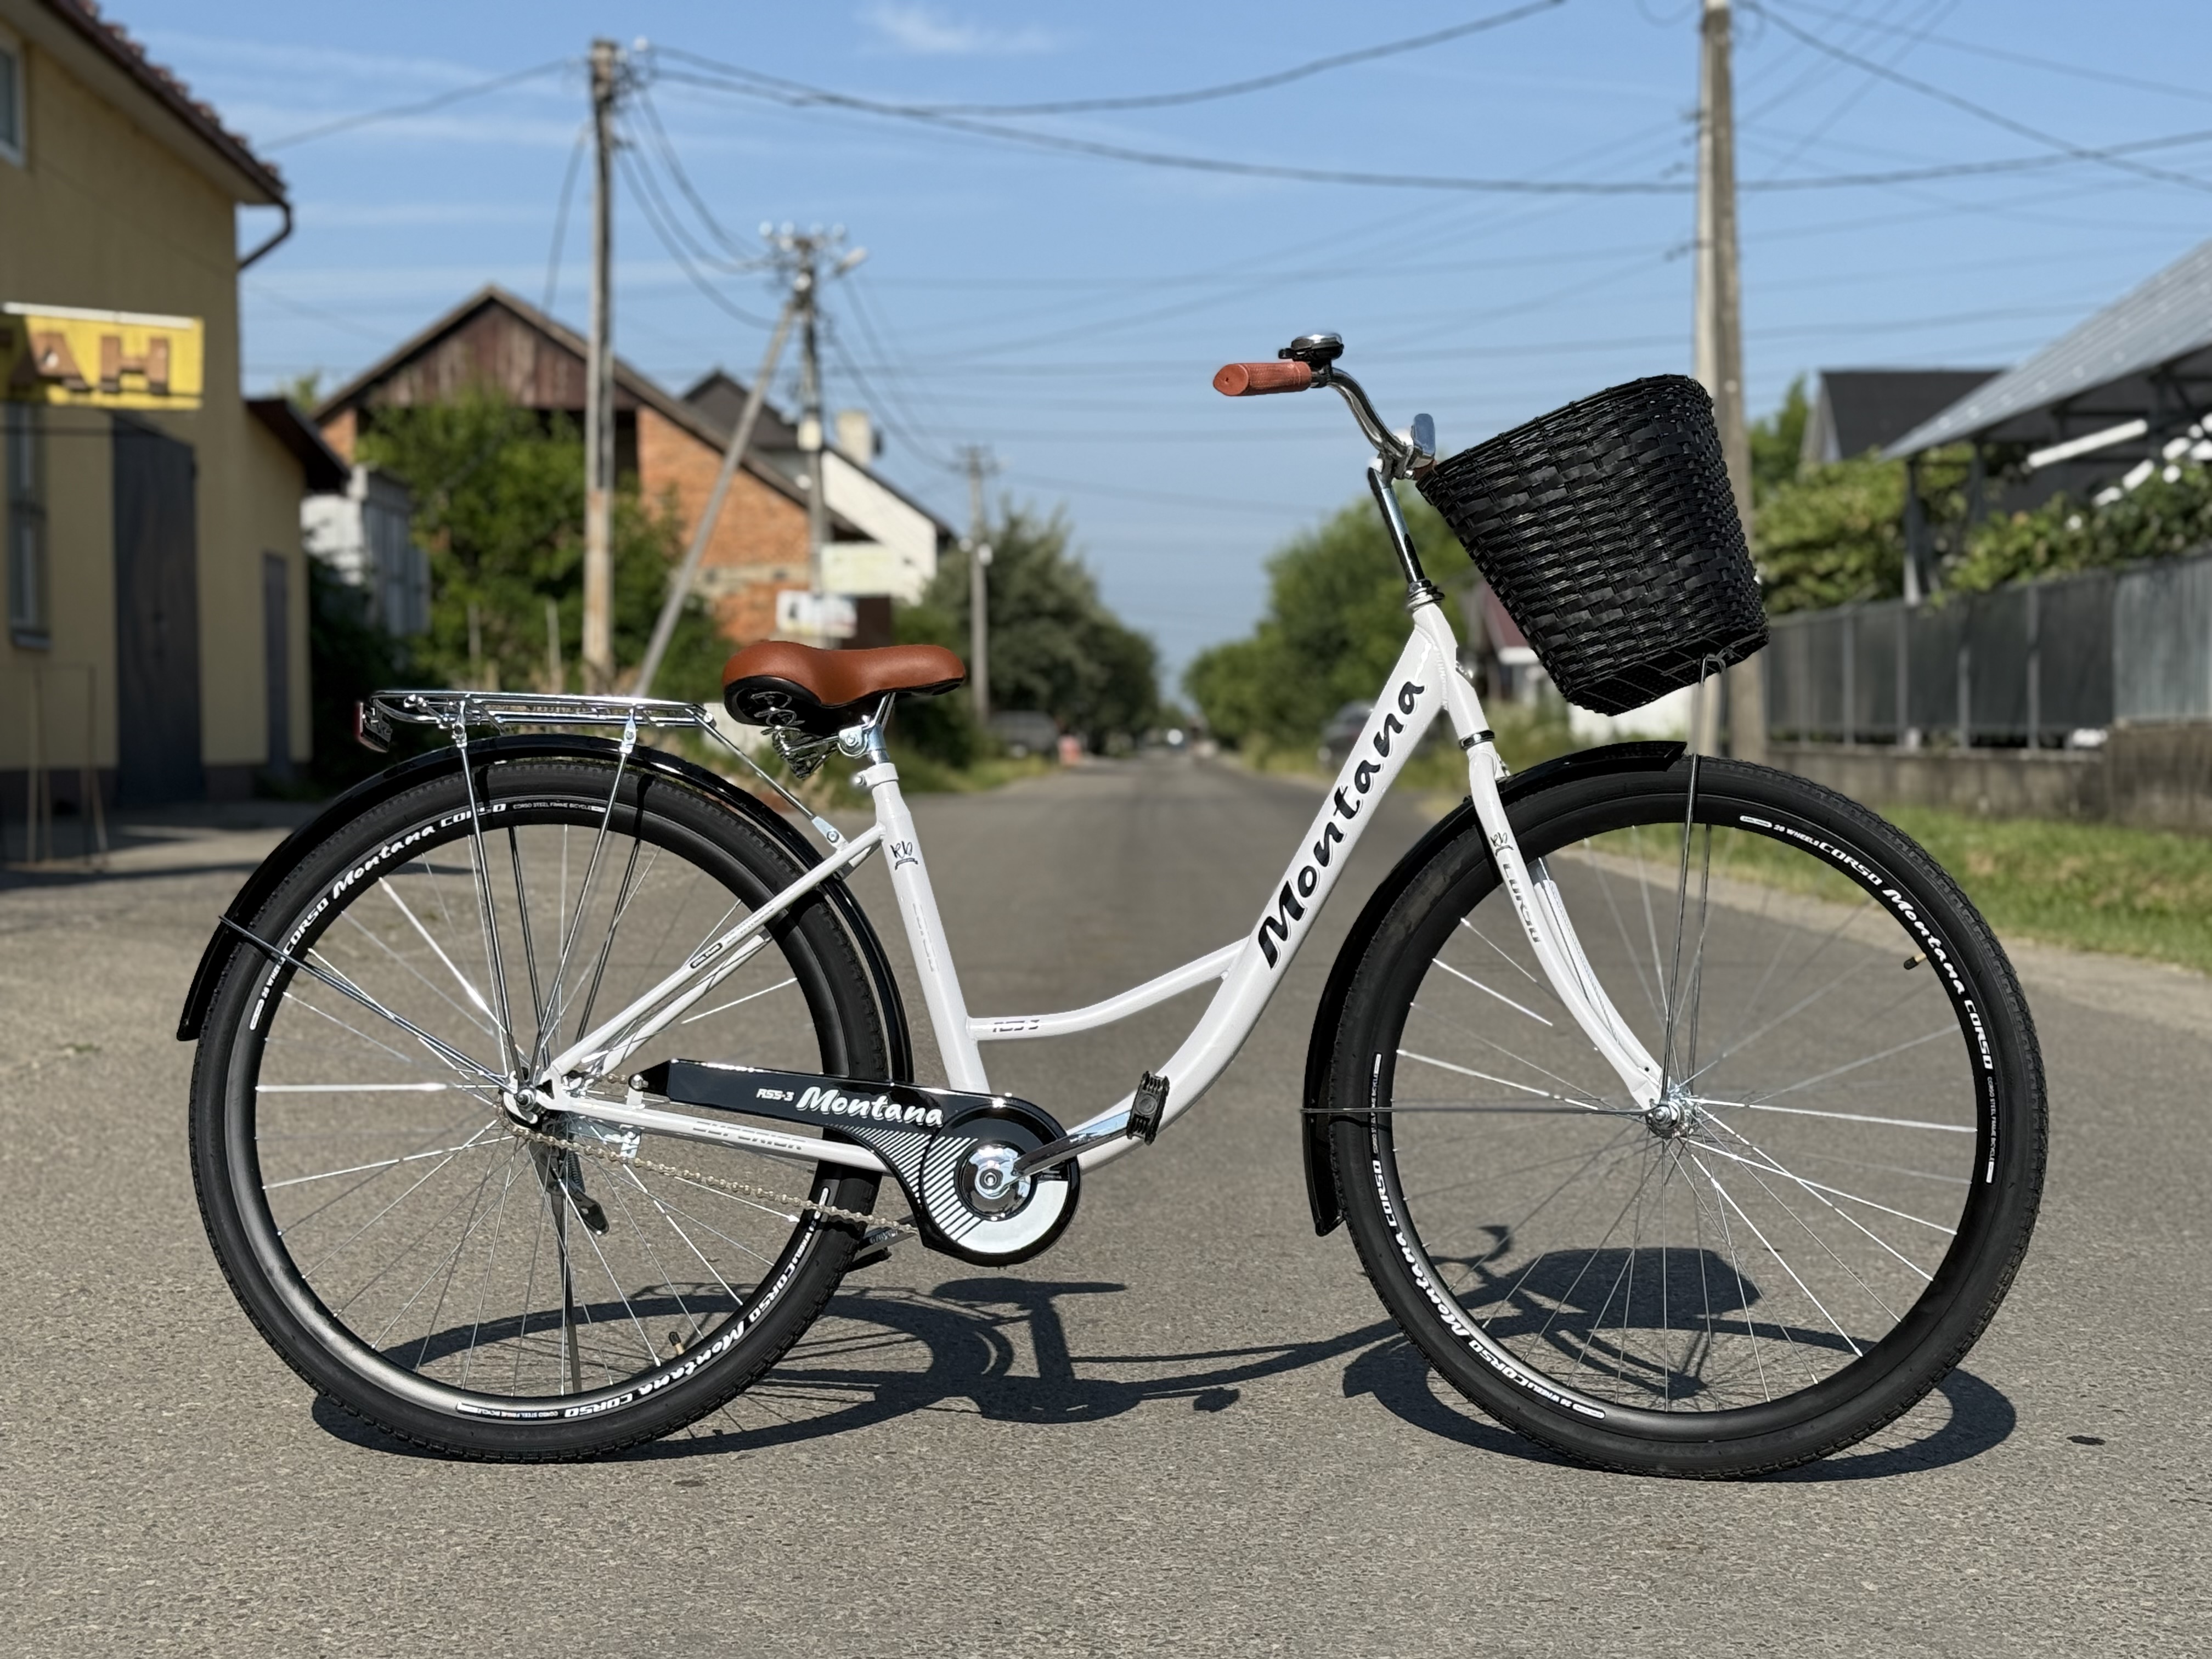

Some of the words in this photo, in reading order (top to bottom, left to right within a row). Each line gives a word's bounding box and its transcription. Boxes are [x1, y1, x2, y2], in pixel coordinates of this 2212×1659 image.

[1258, 681, 1425, 970] Montana
[283, 898, 329, 956] CORSO
[332, 825, 436, 900] Montana
[1786, 828, 1820, 847] WHEELS
[1819, 842, 1883, 886] CORSO
[1882, 889, 1965, 995] Montana
[1963, 1000, 1994, 1070] CORSO
[796, 1086, 944, 1127] Montana
[1373, 1160, 1398, 1227] CORSO
[749, 1262, 795, 1323] CORSO
[1396, 1232, 1470, 1336] Montana
[638, 1321, 744, 1395] Montana
[1469, 1339, 1530, 1387] CORSO
[564, 1393, 633, 1418] CORSO
